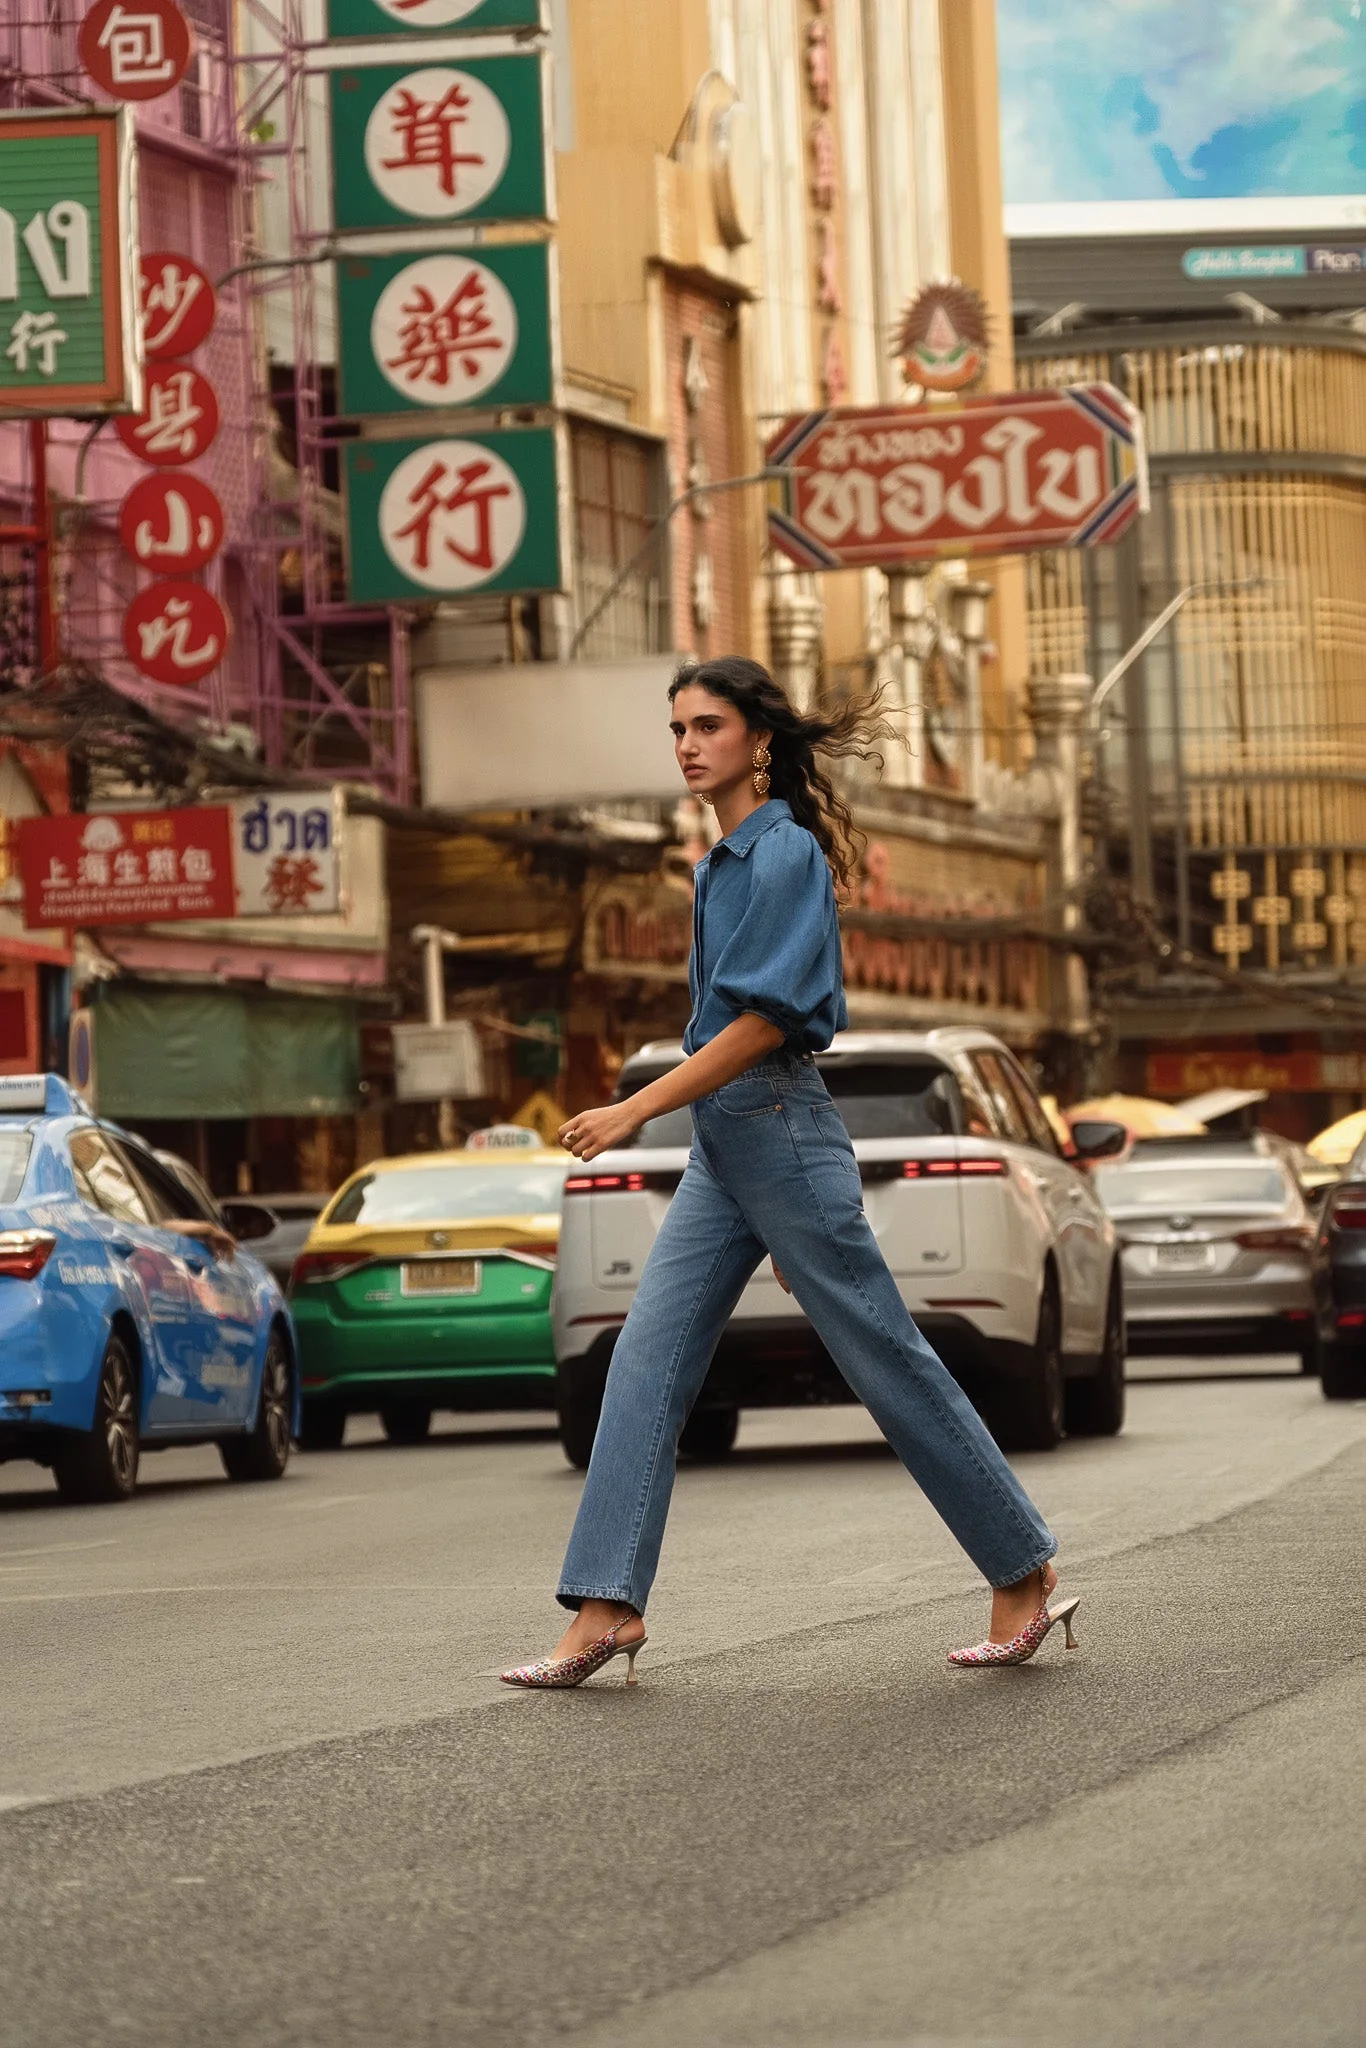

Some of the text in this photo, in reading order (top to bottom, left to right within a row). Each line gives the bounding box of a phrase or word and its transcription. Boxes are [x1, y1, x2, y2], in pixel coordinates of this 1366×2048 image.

[97, 4, 175, 84] 包
[379, 0, 512, 571] 茸藥行
